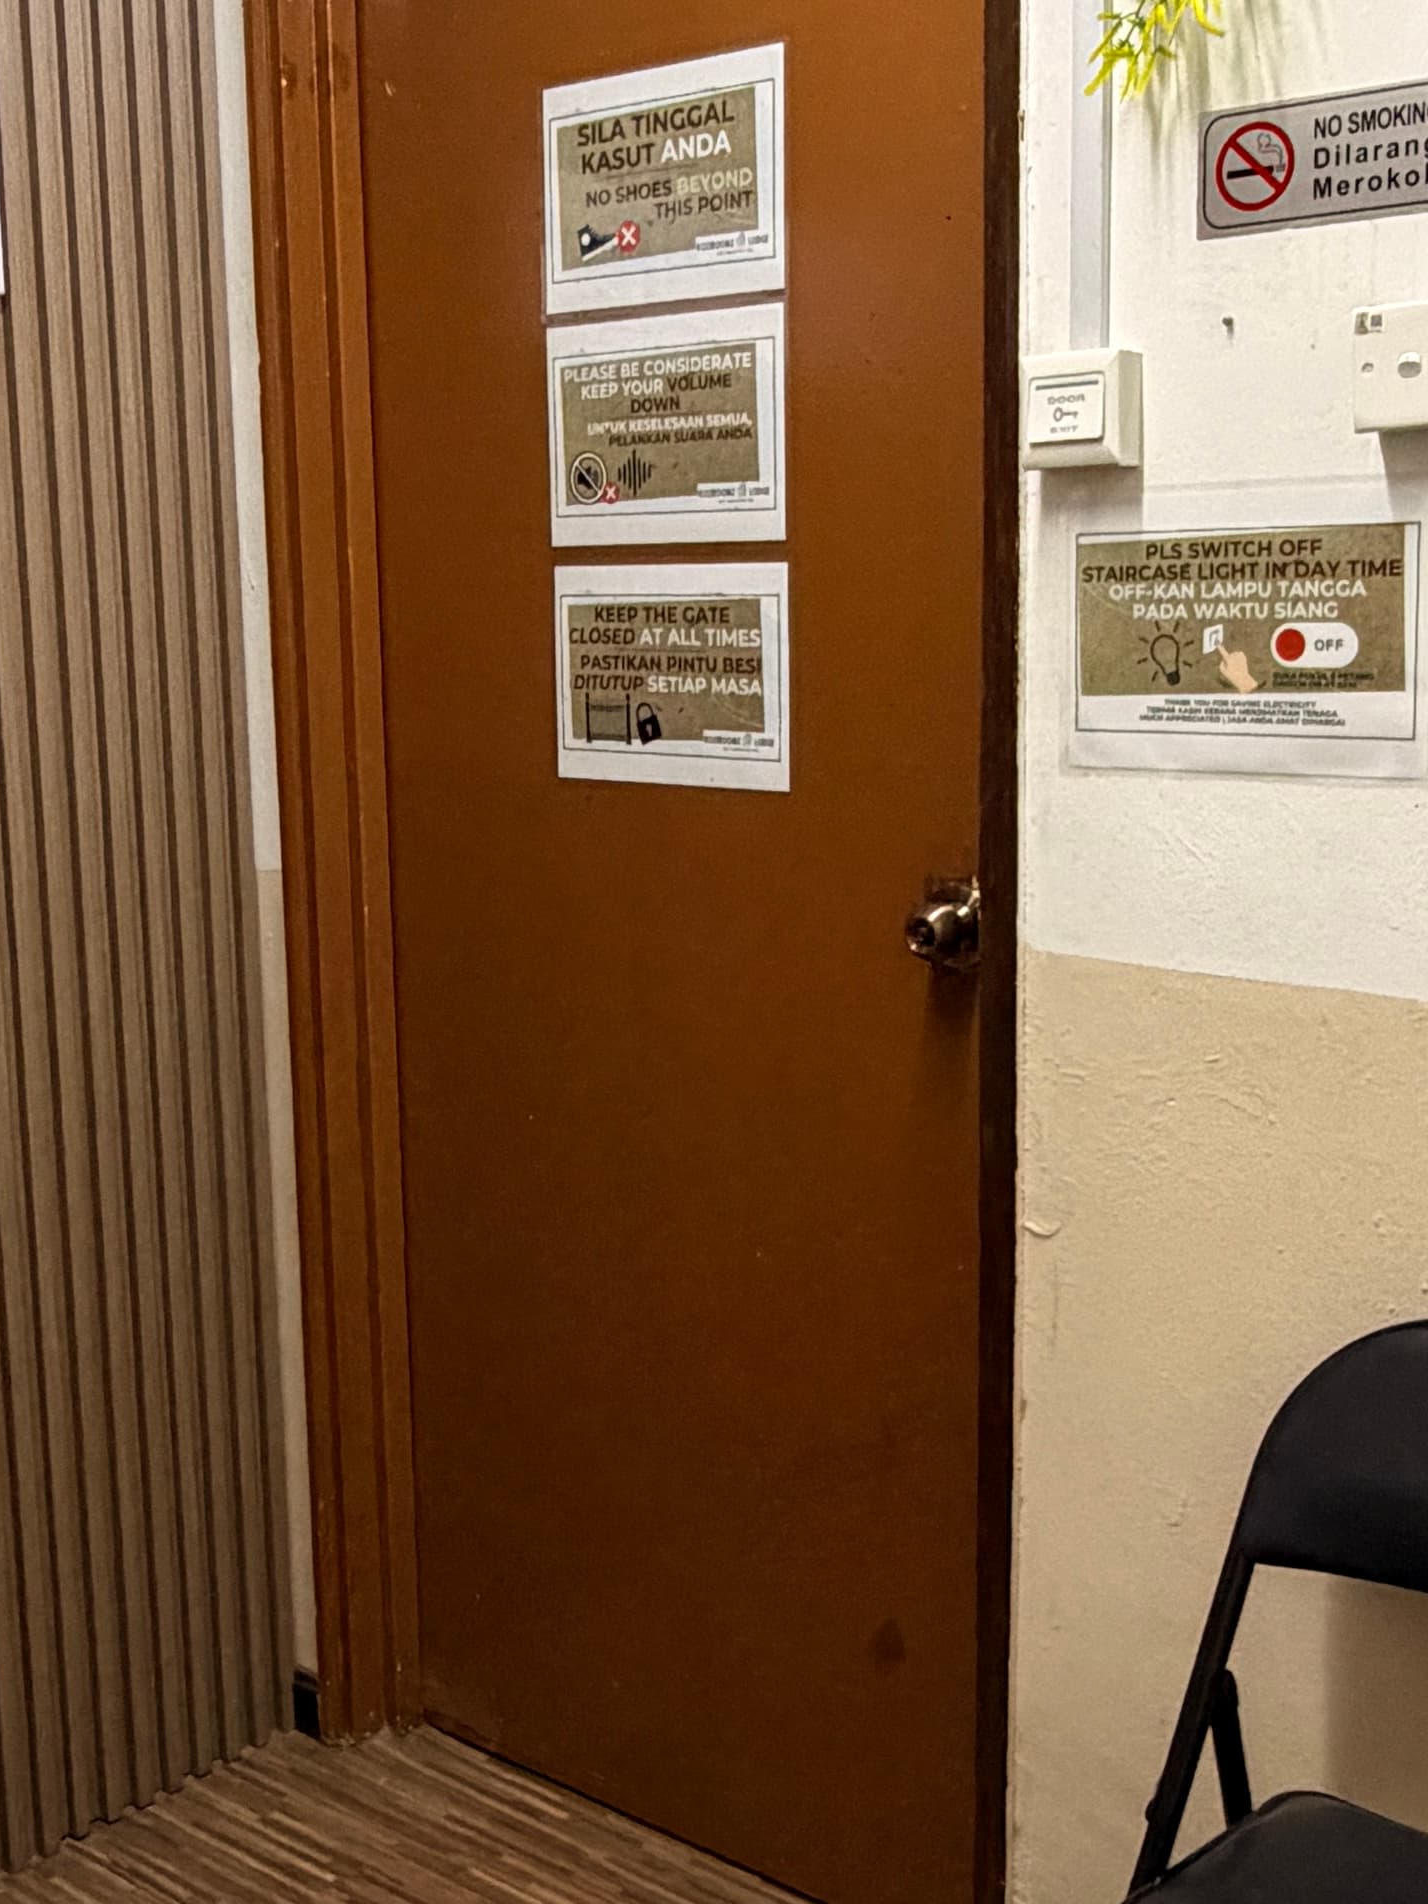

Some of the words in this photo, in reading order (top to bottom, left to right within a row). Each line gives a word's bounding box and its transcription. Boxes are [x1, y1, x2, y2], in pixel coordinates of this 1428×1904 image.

[577, 119, 626, 147] SILA
[632, 99, 735, 137] TINGGAL
[1313, 114, 1342, 140] NO
[581, 142, 655, 175] KASUT
[660, 129, 732, 164] ANDA
[585, 189, 611, 208] NO
[615, 179, 672, 204] SHOES
[676, 166, 754, 195] BEYOND
[655, 198, 693, 219] THIS
[698, 190, 754, 214] POINT
[564, 364, 616, 383] PLEASE
[620, 361, 640, 377] BE
[643, 351, 752, 376] CONSIDERATE
[580, 382, 618, 400] KEEP
[622, 378, 664, 396] YOUR
[667, 373, 733, 393] VOLUME
[630, 395, 681, 414] DOWN
[587, 419, 627, 436] UNTUK
[629, 415, 704, 433] KESELESAAN
[674, 429, 714, 444] SUARA
[716, 427, 753, 442] ANDA
[1145, 543, 1183, 560] PLS
[1187, 540, 1272, 559] SWITCH
[1279, 539, 1323, 557] OFF
[1082, 563, 1191, 583] STAIRCASE
[1197, 561, 1259, 581] LIGHT
[1265, 561, 1287, 579] IN
[1294, 560, 1341, 578] DAY
[1347, 559, 1402, 577] TIME
[1108, 582, 1195, 601] OFF-KAN
[1200, 580, 1272, 600] LAMPU
[1277, 578, 1368, 598] TANGGA
[594, 607, 638, 624] KEEP
[642, 606, 678, 624] THE
[682, 606, 730, 625] GATE
[1132, 602, 1188, 620] PADA
[1193, 602, 1269, 620] WAKTU
[1274, 601, 1339, 620] SIANG
[569, 627, 636, 645] CLOSED
[639, 628, 664, 646] AT
[667, 628, 701, 647] ALL
[704, 628, 761, 648] TIMES
[1313, 638, 1344, 652] OFF
[580, 654, 662, 672] PASTIKAN
[666, 655, 718, 674] PINTU
[574, 674, 644, 691] DITUTUP
[647, 675, 707, 694] SETIAP
[711, 678, 762, 696] MASA
